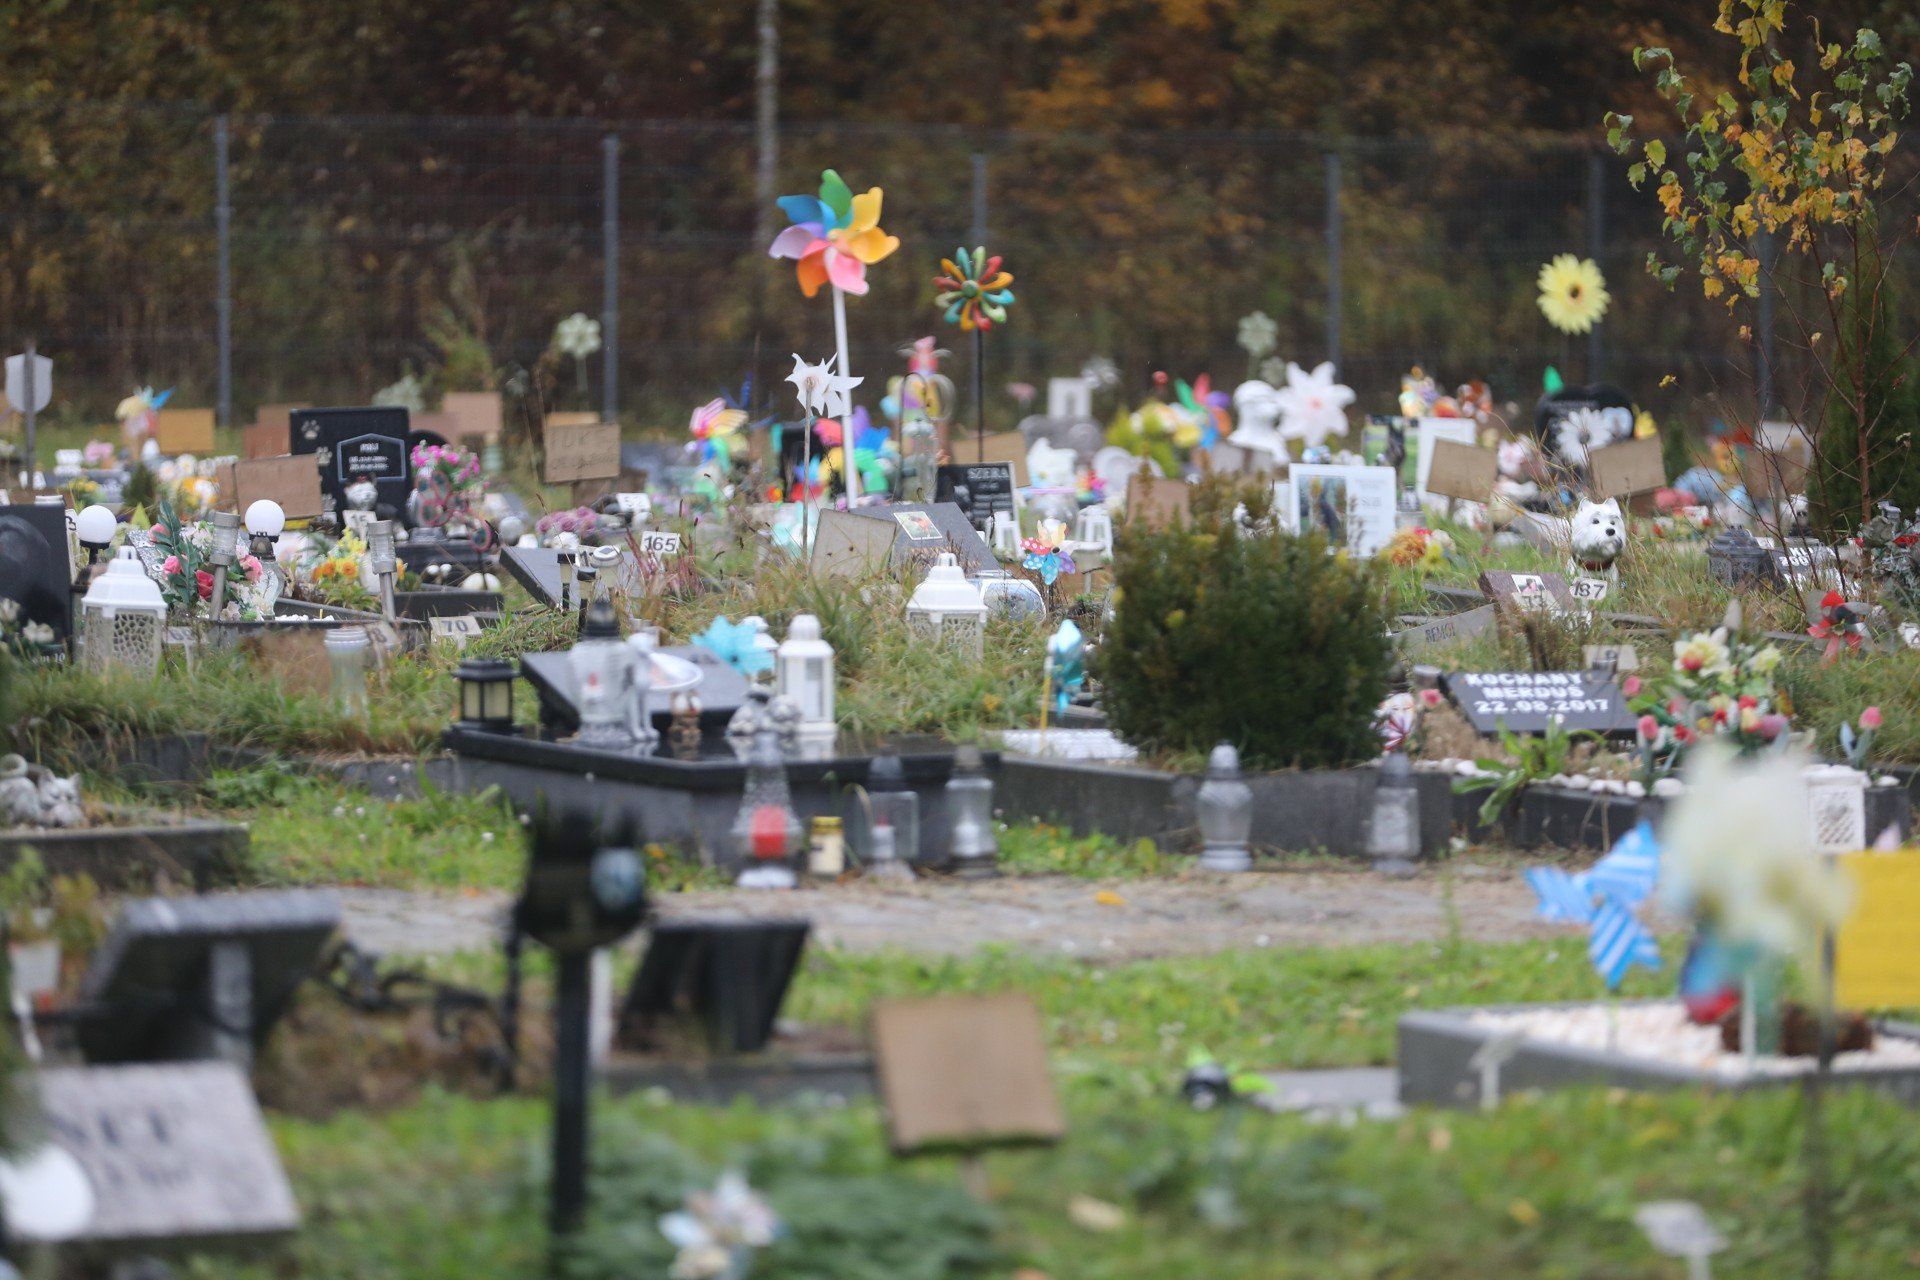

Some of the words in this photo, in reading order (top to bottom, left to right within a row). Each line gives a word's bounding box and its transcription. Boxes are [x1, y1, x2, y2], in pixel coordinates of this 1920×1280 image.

[643, 535, 677, 552] 165
[1573, 581, 1605, 599] 187
[441, 619, 468, 633] 70
[1464, 673, 1581, 687] KOCHANY
